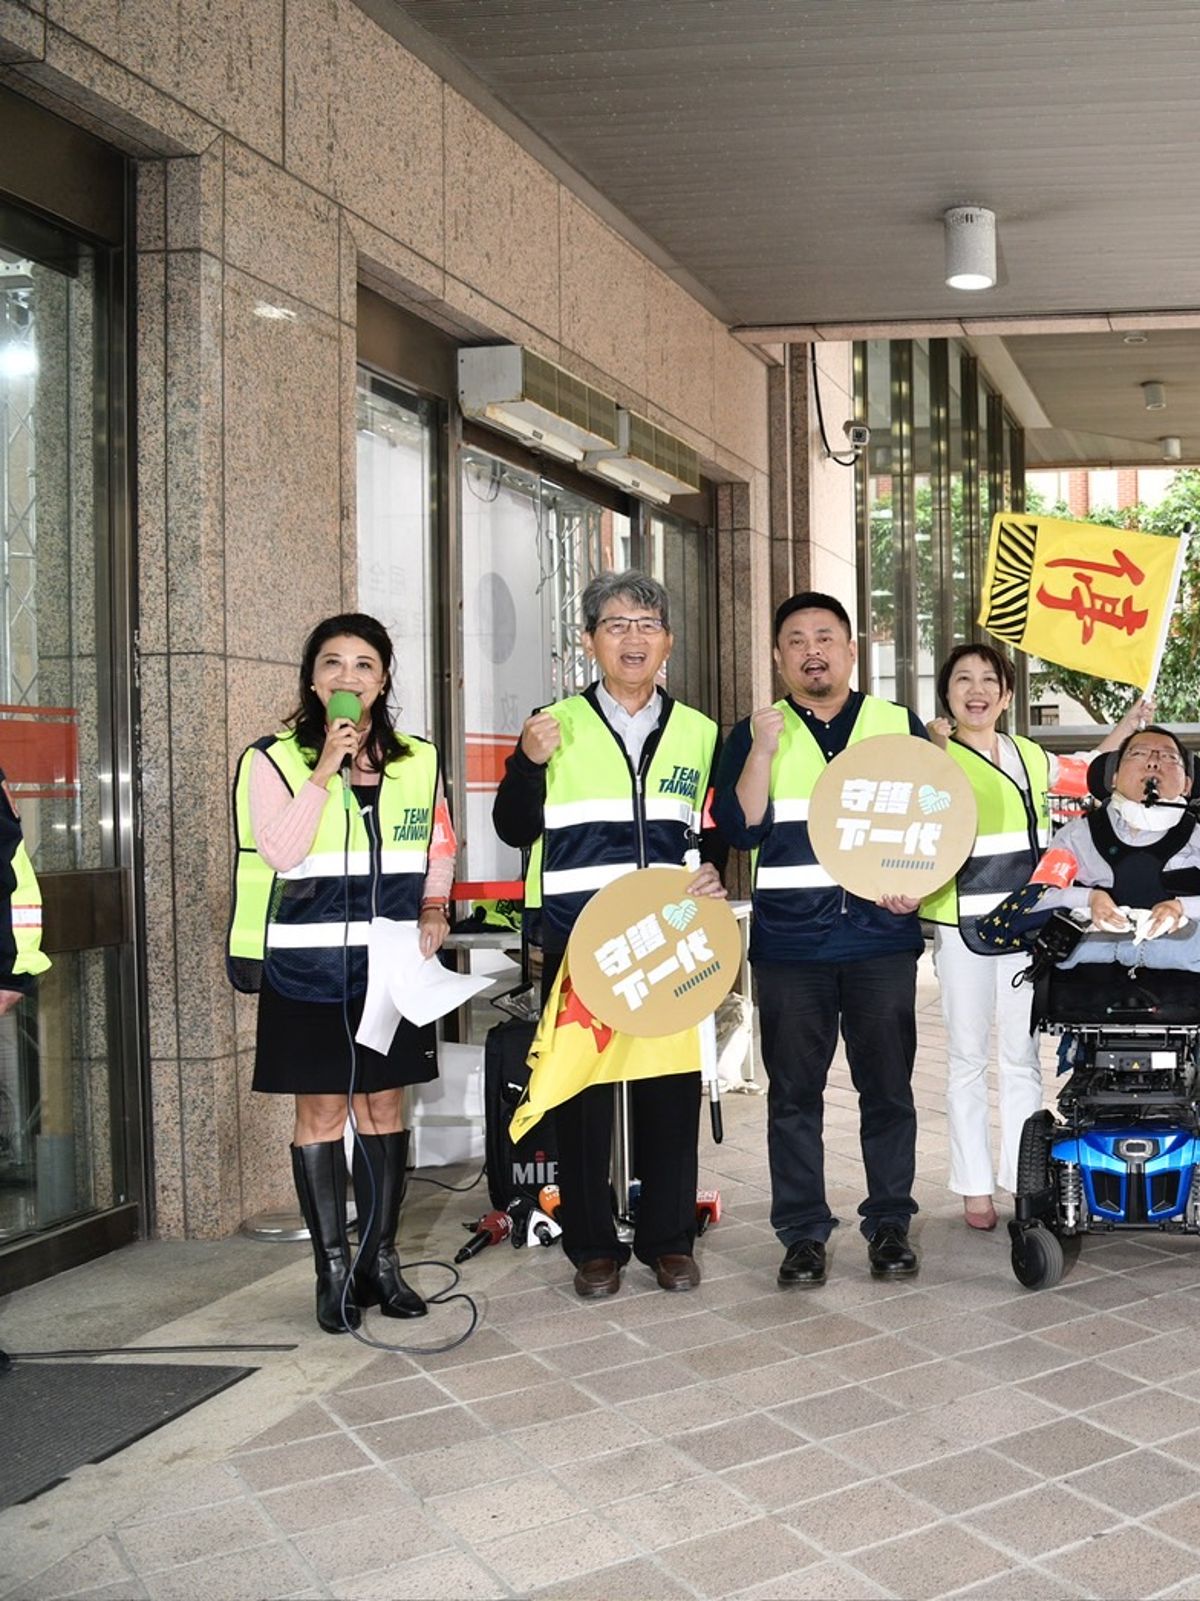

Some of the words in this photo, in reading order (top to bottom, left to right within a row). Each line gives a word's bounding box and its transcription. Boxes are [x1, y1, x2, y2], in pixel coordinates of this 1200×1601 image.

[1036, 548, 1149, 645] 停
[672, 765, 701, 784] TEAM
[403, 807, 430, 825] TEAM
[840, 778, 915, 816] 守護
[835, 817, 943, 857] 下一代
[593, 914, 668, 978] 守護
[612, 926, 716, 1012] 下一代
